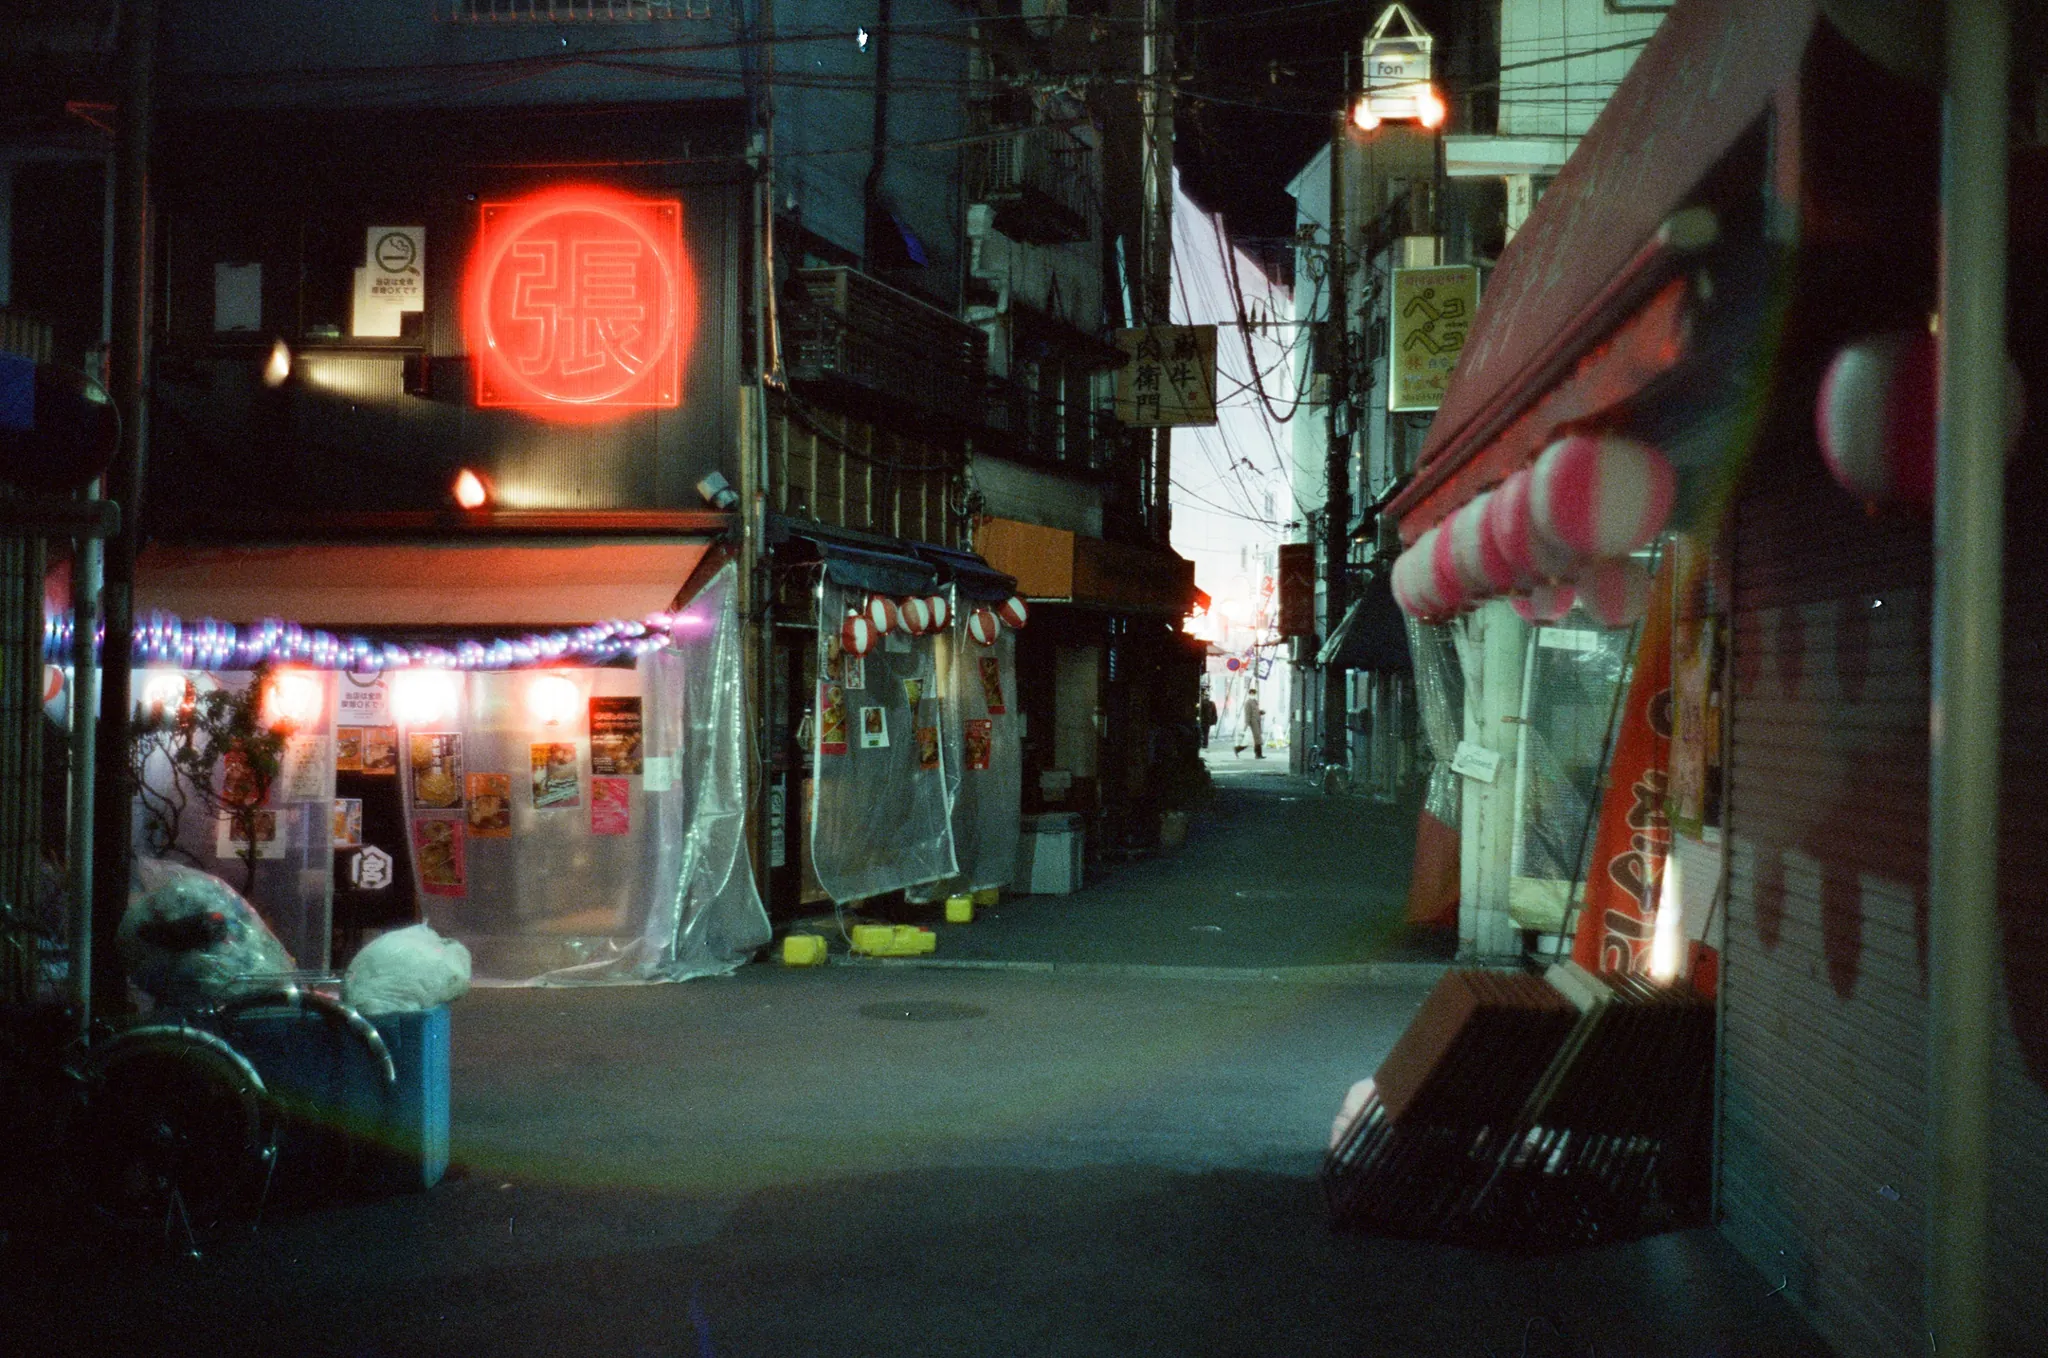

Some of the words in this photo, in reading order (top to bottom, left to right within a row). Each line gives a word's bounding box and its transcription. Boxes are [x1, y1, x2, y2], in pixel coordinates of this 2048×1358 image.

[1377, 62, 1404, 75] fon
[512, 239, 644, 376] 張
[1402, 288, 1465, 321] ペコ
